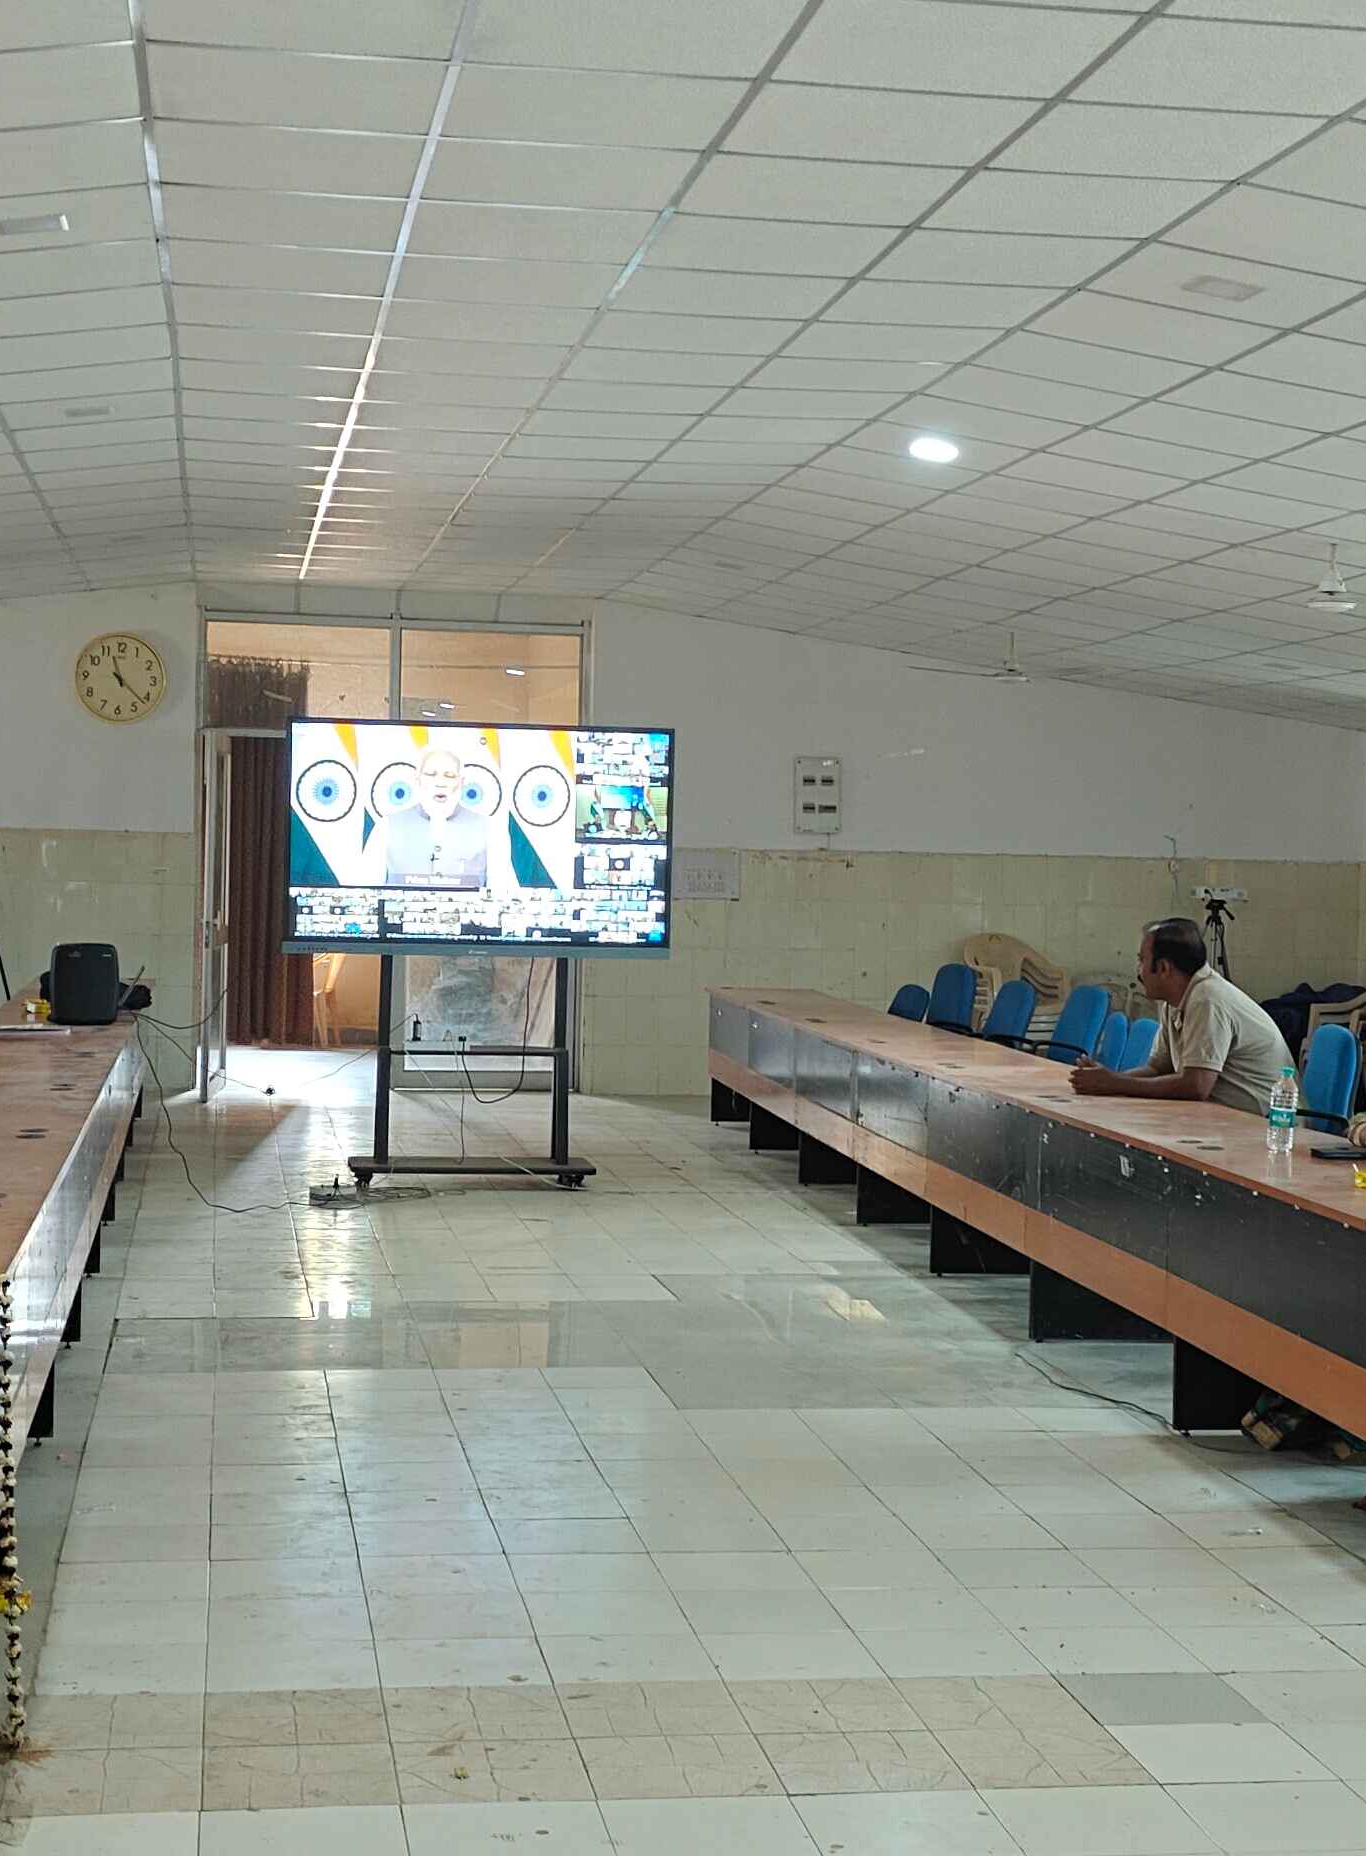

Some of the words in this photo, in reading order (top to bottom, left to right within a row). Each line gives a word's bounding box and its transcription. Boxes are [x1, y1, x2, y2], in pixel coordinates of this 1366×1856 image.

[101, 645, 110, 657] 11
[117, 642, 127, 653] 12
[90, 654, 101, 666] 10
[145, 660, 153, 671] 2
[82, 670, 90, 681] 9
[149, 676, 157, 687] 3
[86, 686, 94, 698] 8
[143, 691, 150, 702] 4
[100, 699, 108, 711] 7
[114, 705, 121, 715] 6
[131, 701, 138, 712] 5
